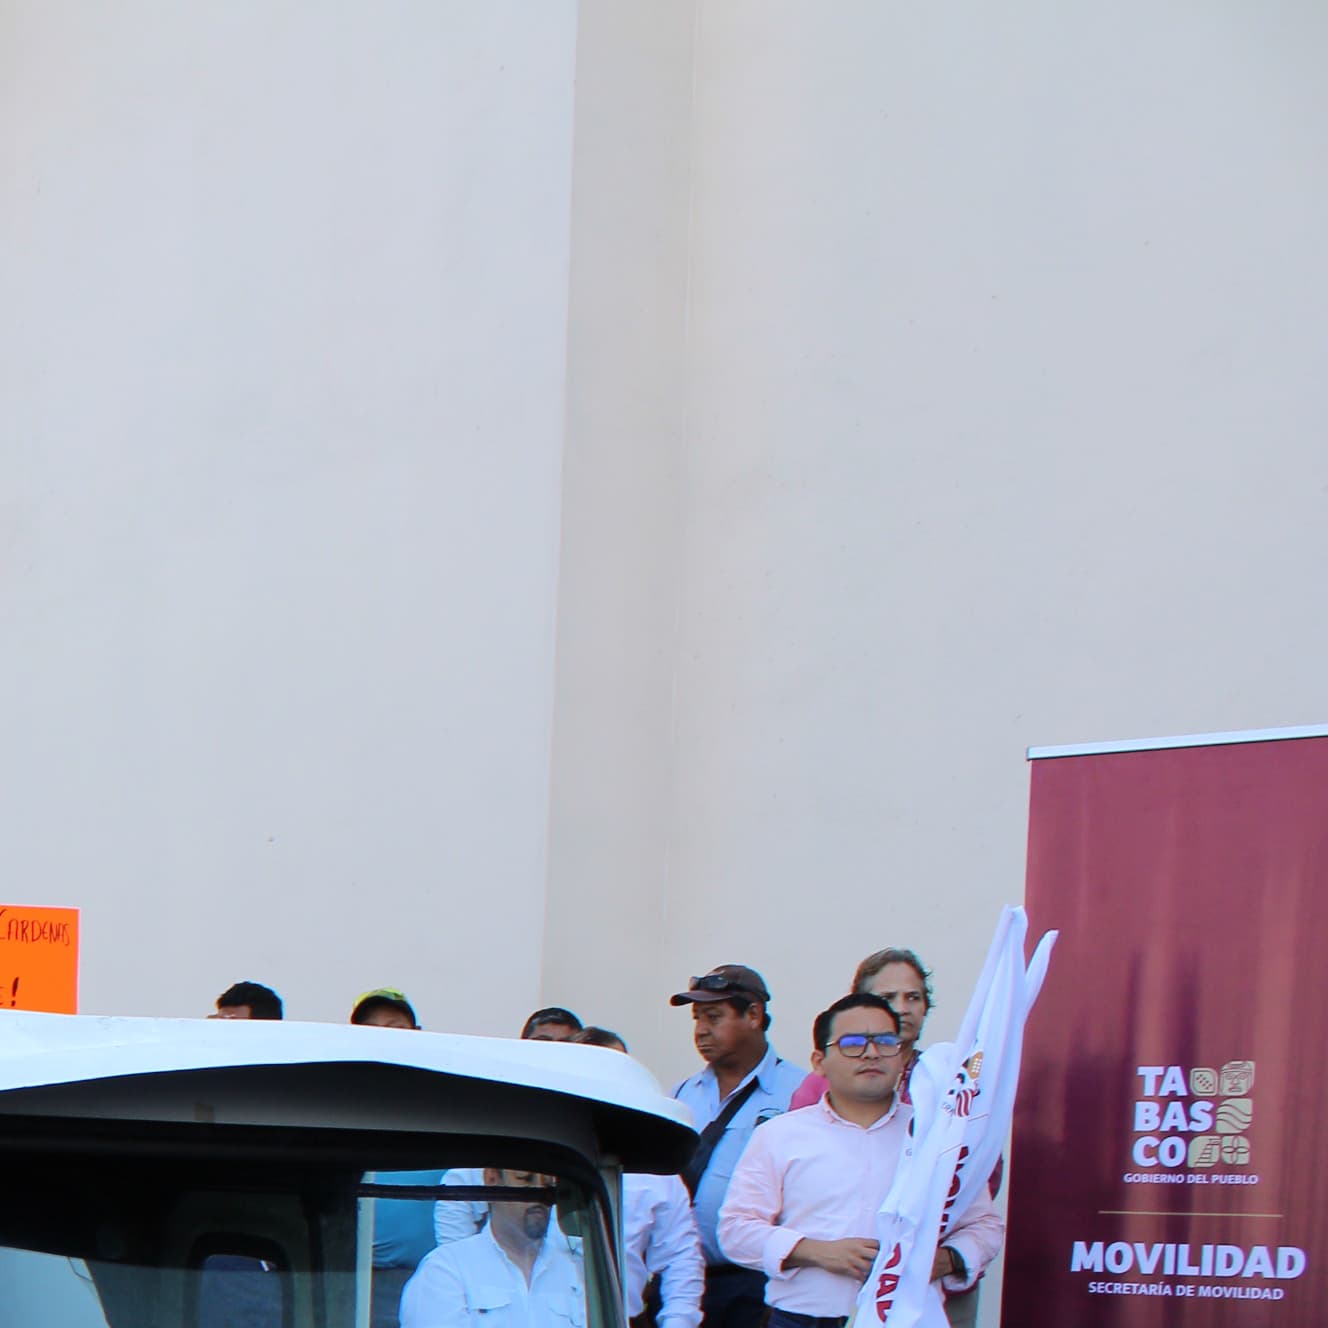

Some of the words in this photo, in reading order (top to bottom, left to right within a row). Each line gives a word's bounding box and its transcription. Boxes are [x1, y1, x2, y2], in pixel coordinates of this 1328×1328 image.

[1137, 1066, 1188, 1097] TA
[1134, 1101, 1214, 1132] BAS
[1132, 1135, 1187, 1168] CO
[1124, 1172, 1185, 1185] GOBIERNO
[1187, 1173, 1209, 1185] DEL
[1211, 1174, 1259, 1186] PUEBLO
[1071, 1241, 1306, 1280] MOVILIDAD
[1088, 1280, 1172, 1297] SECRETARÍA
[1176, 1284, 1195, 1297] DE
[1198, 1284, 1284, 1301] MOVILIDAD
